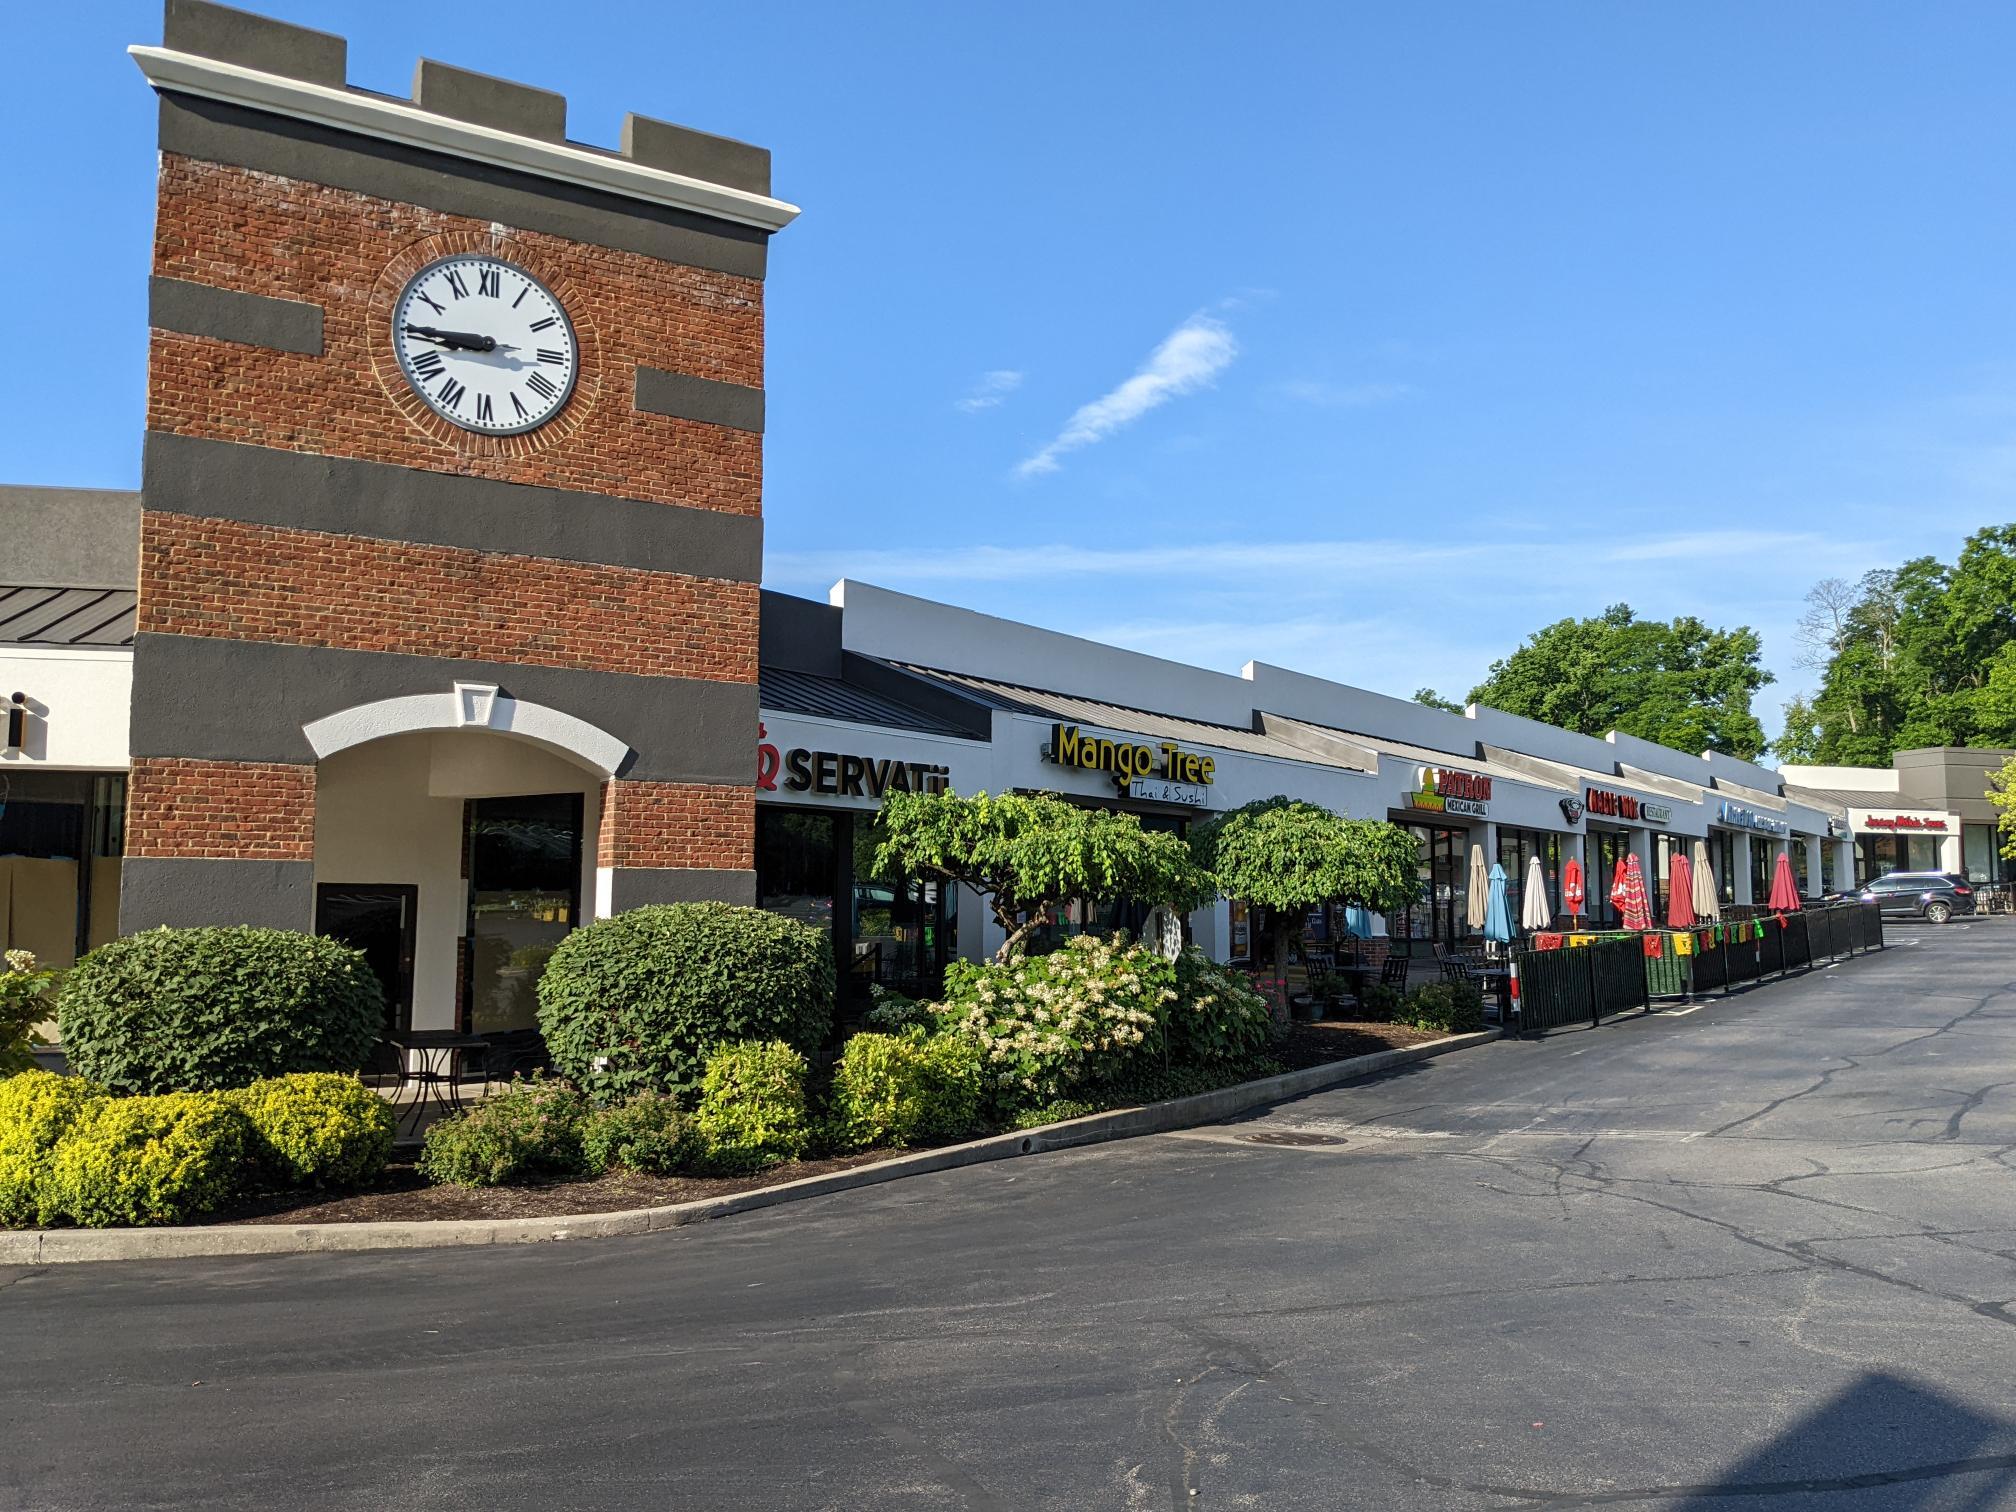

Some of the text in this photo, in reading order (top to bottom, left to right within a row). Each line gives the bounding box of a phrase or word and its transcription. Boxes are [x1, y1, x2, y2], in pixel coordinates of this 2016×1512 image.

[443, 269, 470, 301] XI
[478, 268, 501, 299] XII
[416, 290, 447, 316] X
[511, 286, 530, 309] I
[529, 316, 557, 333] II
[536, 348, 565, 366] III
[1053, 723, 1216, 787] Mango Tree
[1131, 780, 1206, 806] Thai & Sushi
[1438, 768, 1493, 801] PATRON
[1446, 798, 1487, 816] MEXICAN GRILL
[1646, 805, 1670, 820] RESTAURANT
